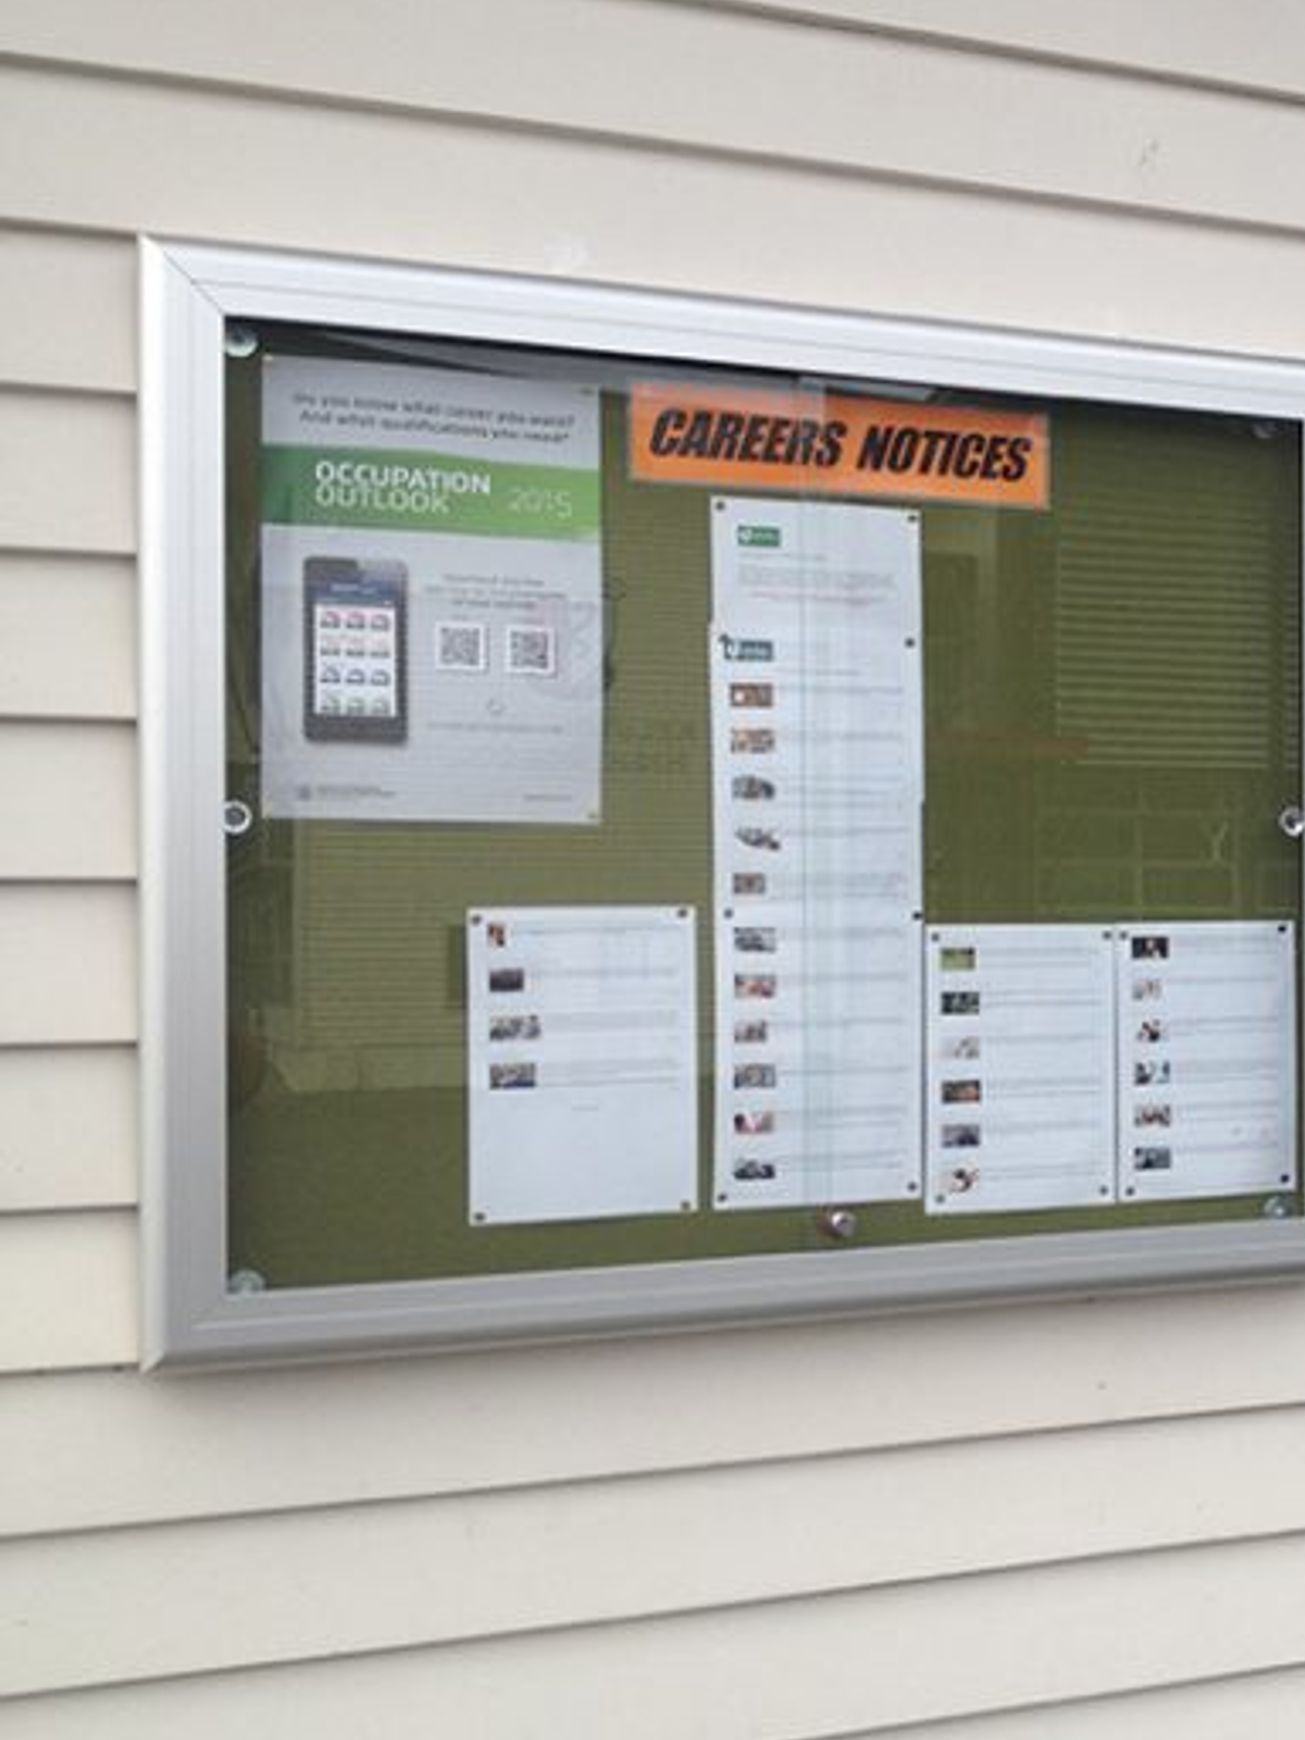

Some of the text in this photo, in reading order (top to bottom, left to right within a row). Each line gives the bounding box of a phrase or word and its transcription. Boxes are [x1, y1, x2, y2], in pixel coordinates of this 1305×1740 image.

[649, 408, 1032, 482] CAREERS NOTICES
[314, 459, 492, 496] OCCUPATION
[314, 482, 574, 519] OUTLOOK 2015
